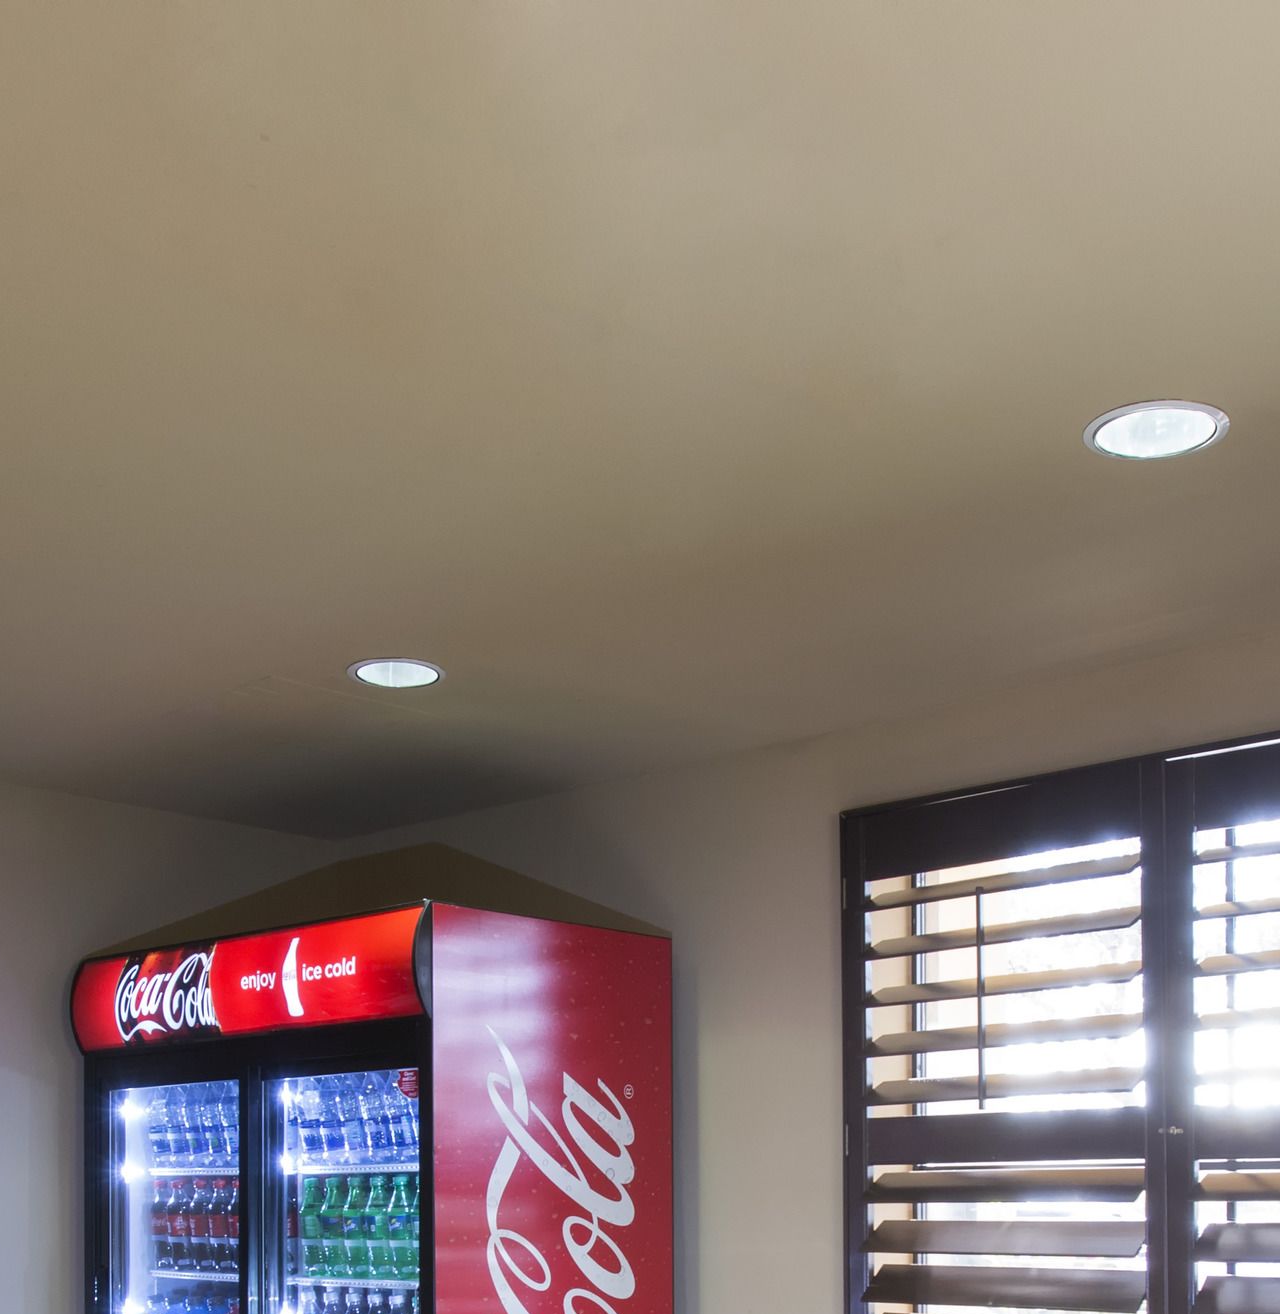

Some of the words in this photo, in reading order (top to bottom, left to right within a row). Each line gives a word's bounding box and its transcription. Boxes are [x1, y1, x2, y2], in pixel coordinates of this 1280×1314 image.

[241, 970, 277, 990] enjoy
[302, 961, 322, 982] ice
[325, 956, 356, 977] cold
